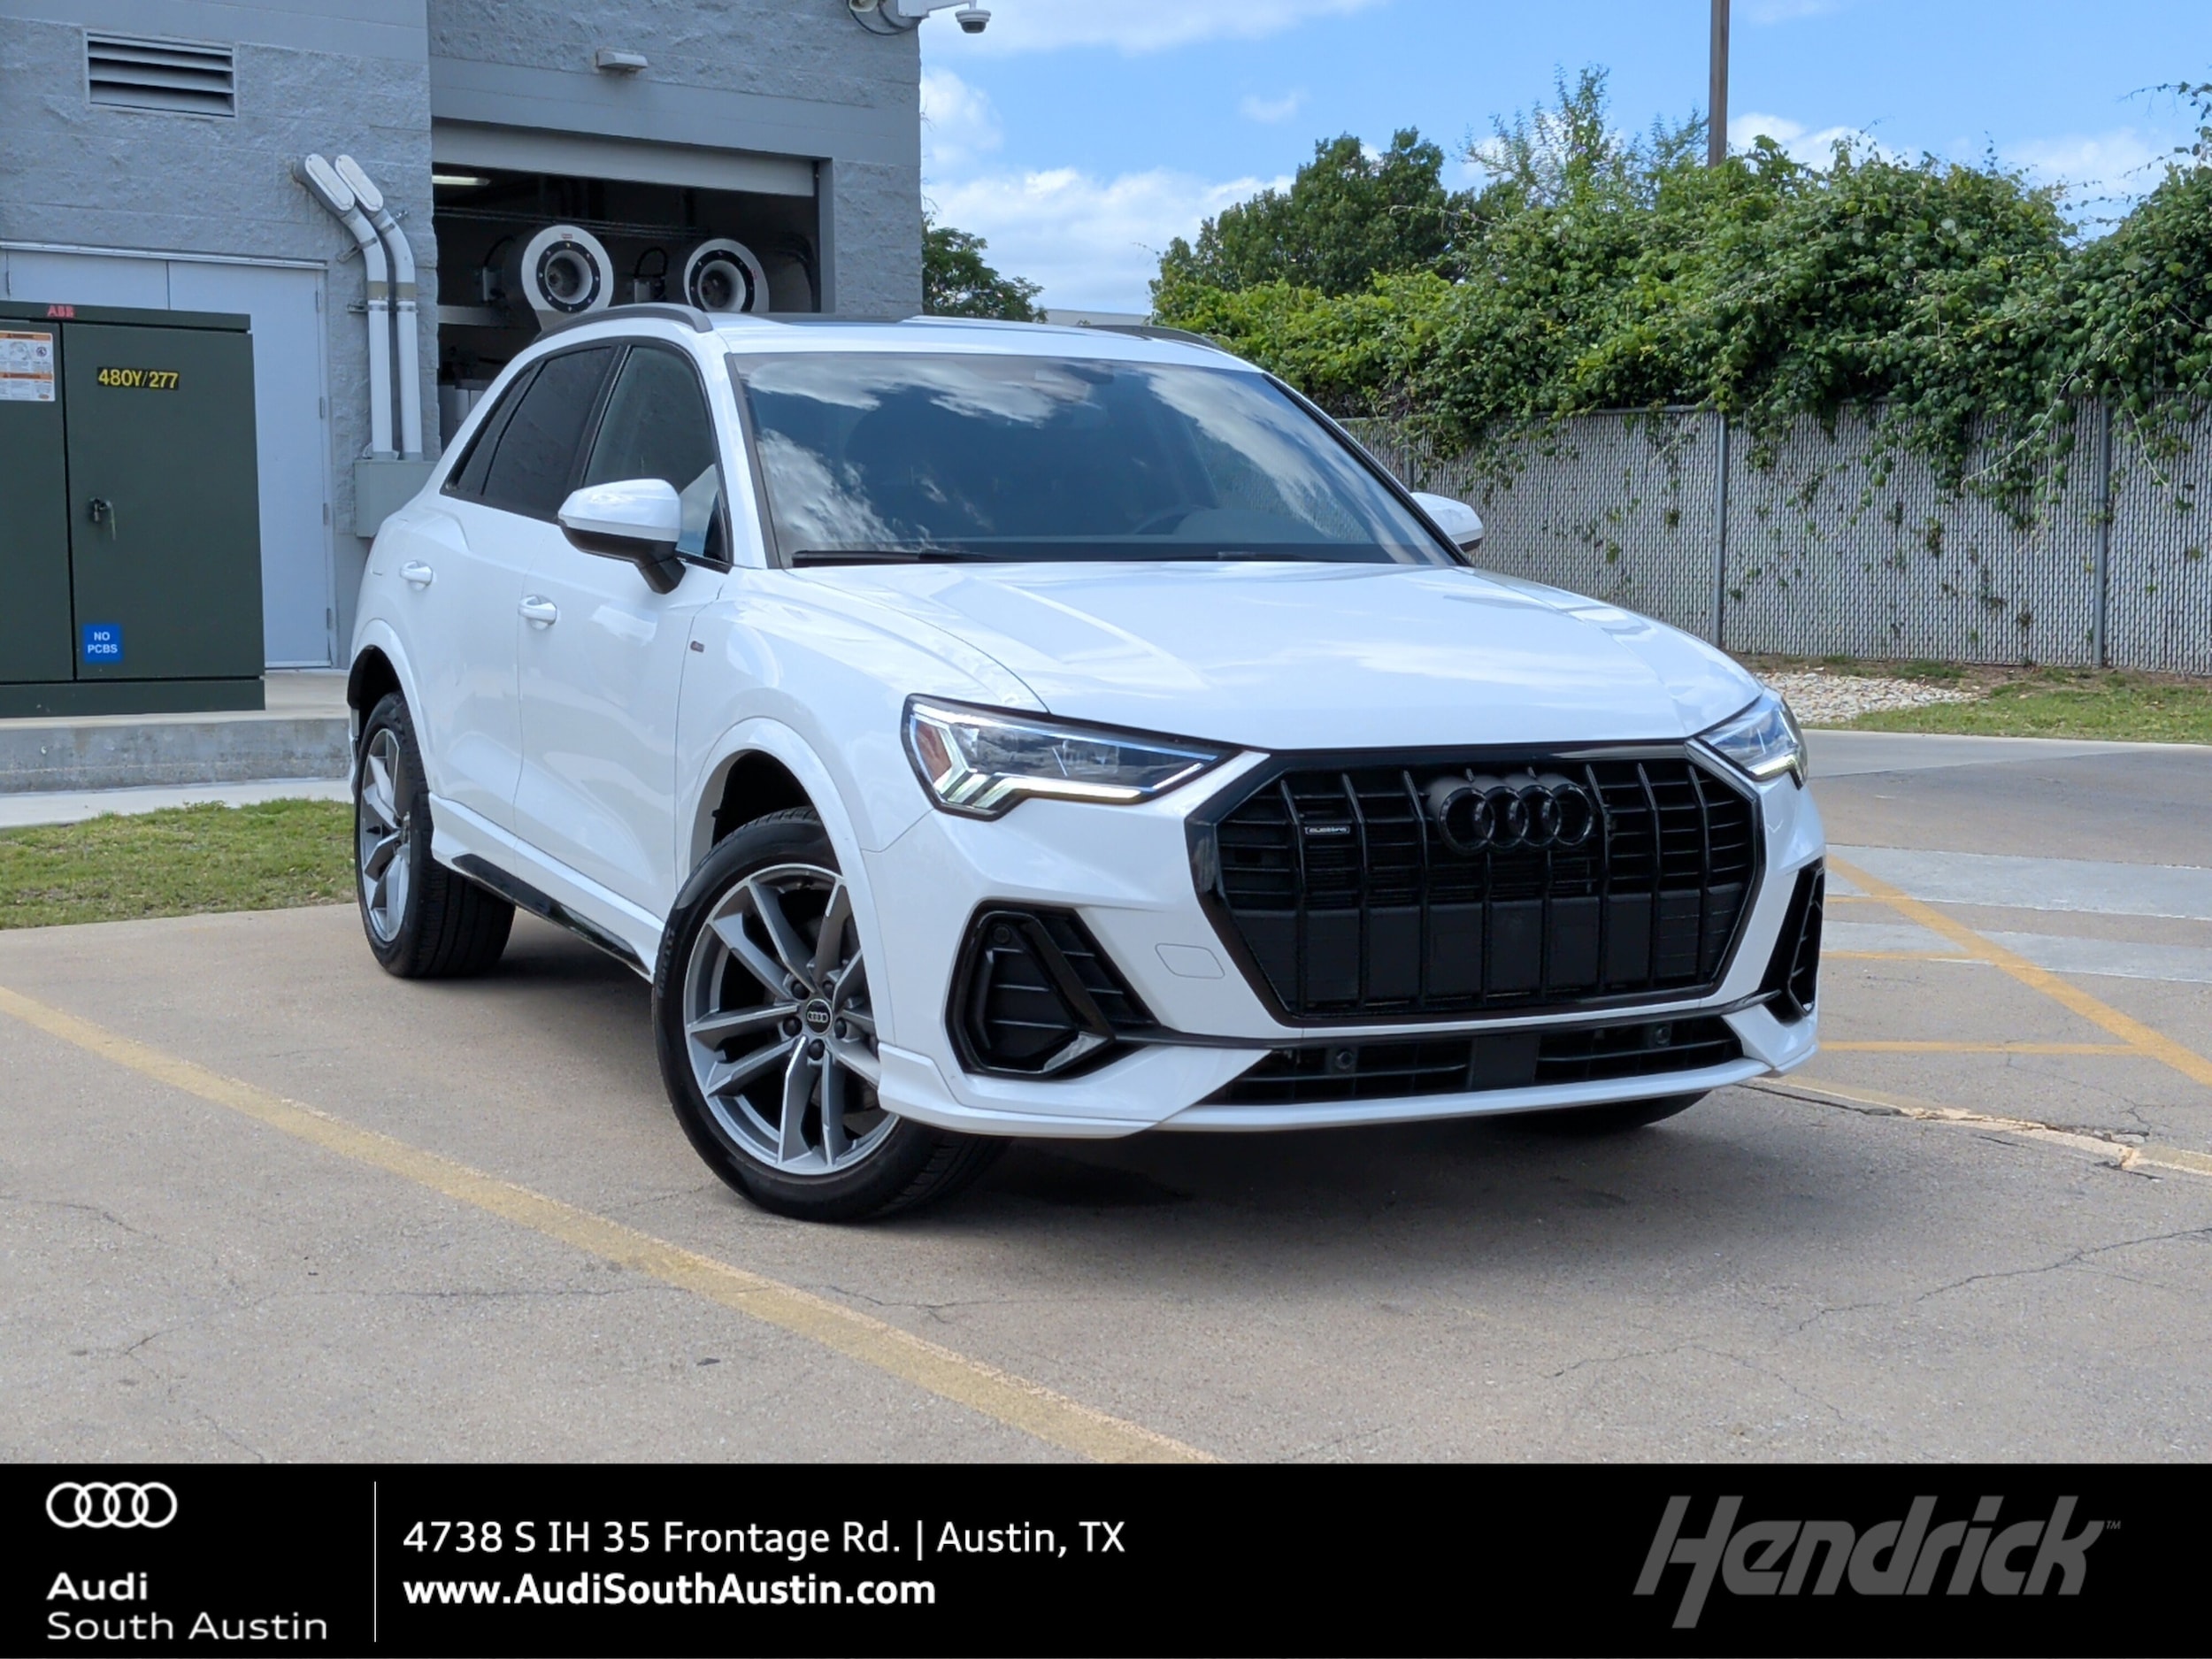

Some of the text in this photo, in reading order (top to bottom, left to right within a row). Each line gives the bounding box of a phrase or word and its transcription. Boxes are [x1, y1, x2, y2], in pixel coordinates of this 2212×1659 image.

[97, 368, 179, 388] 480Y/277
[93, 631, 111, 641] NO
[87, 643, 118, 654] PCBS
